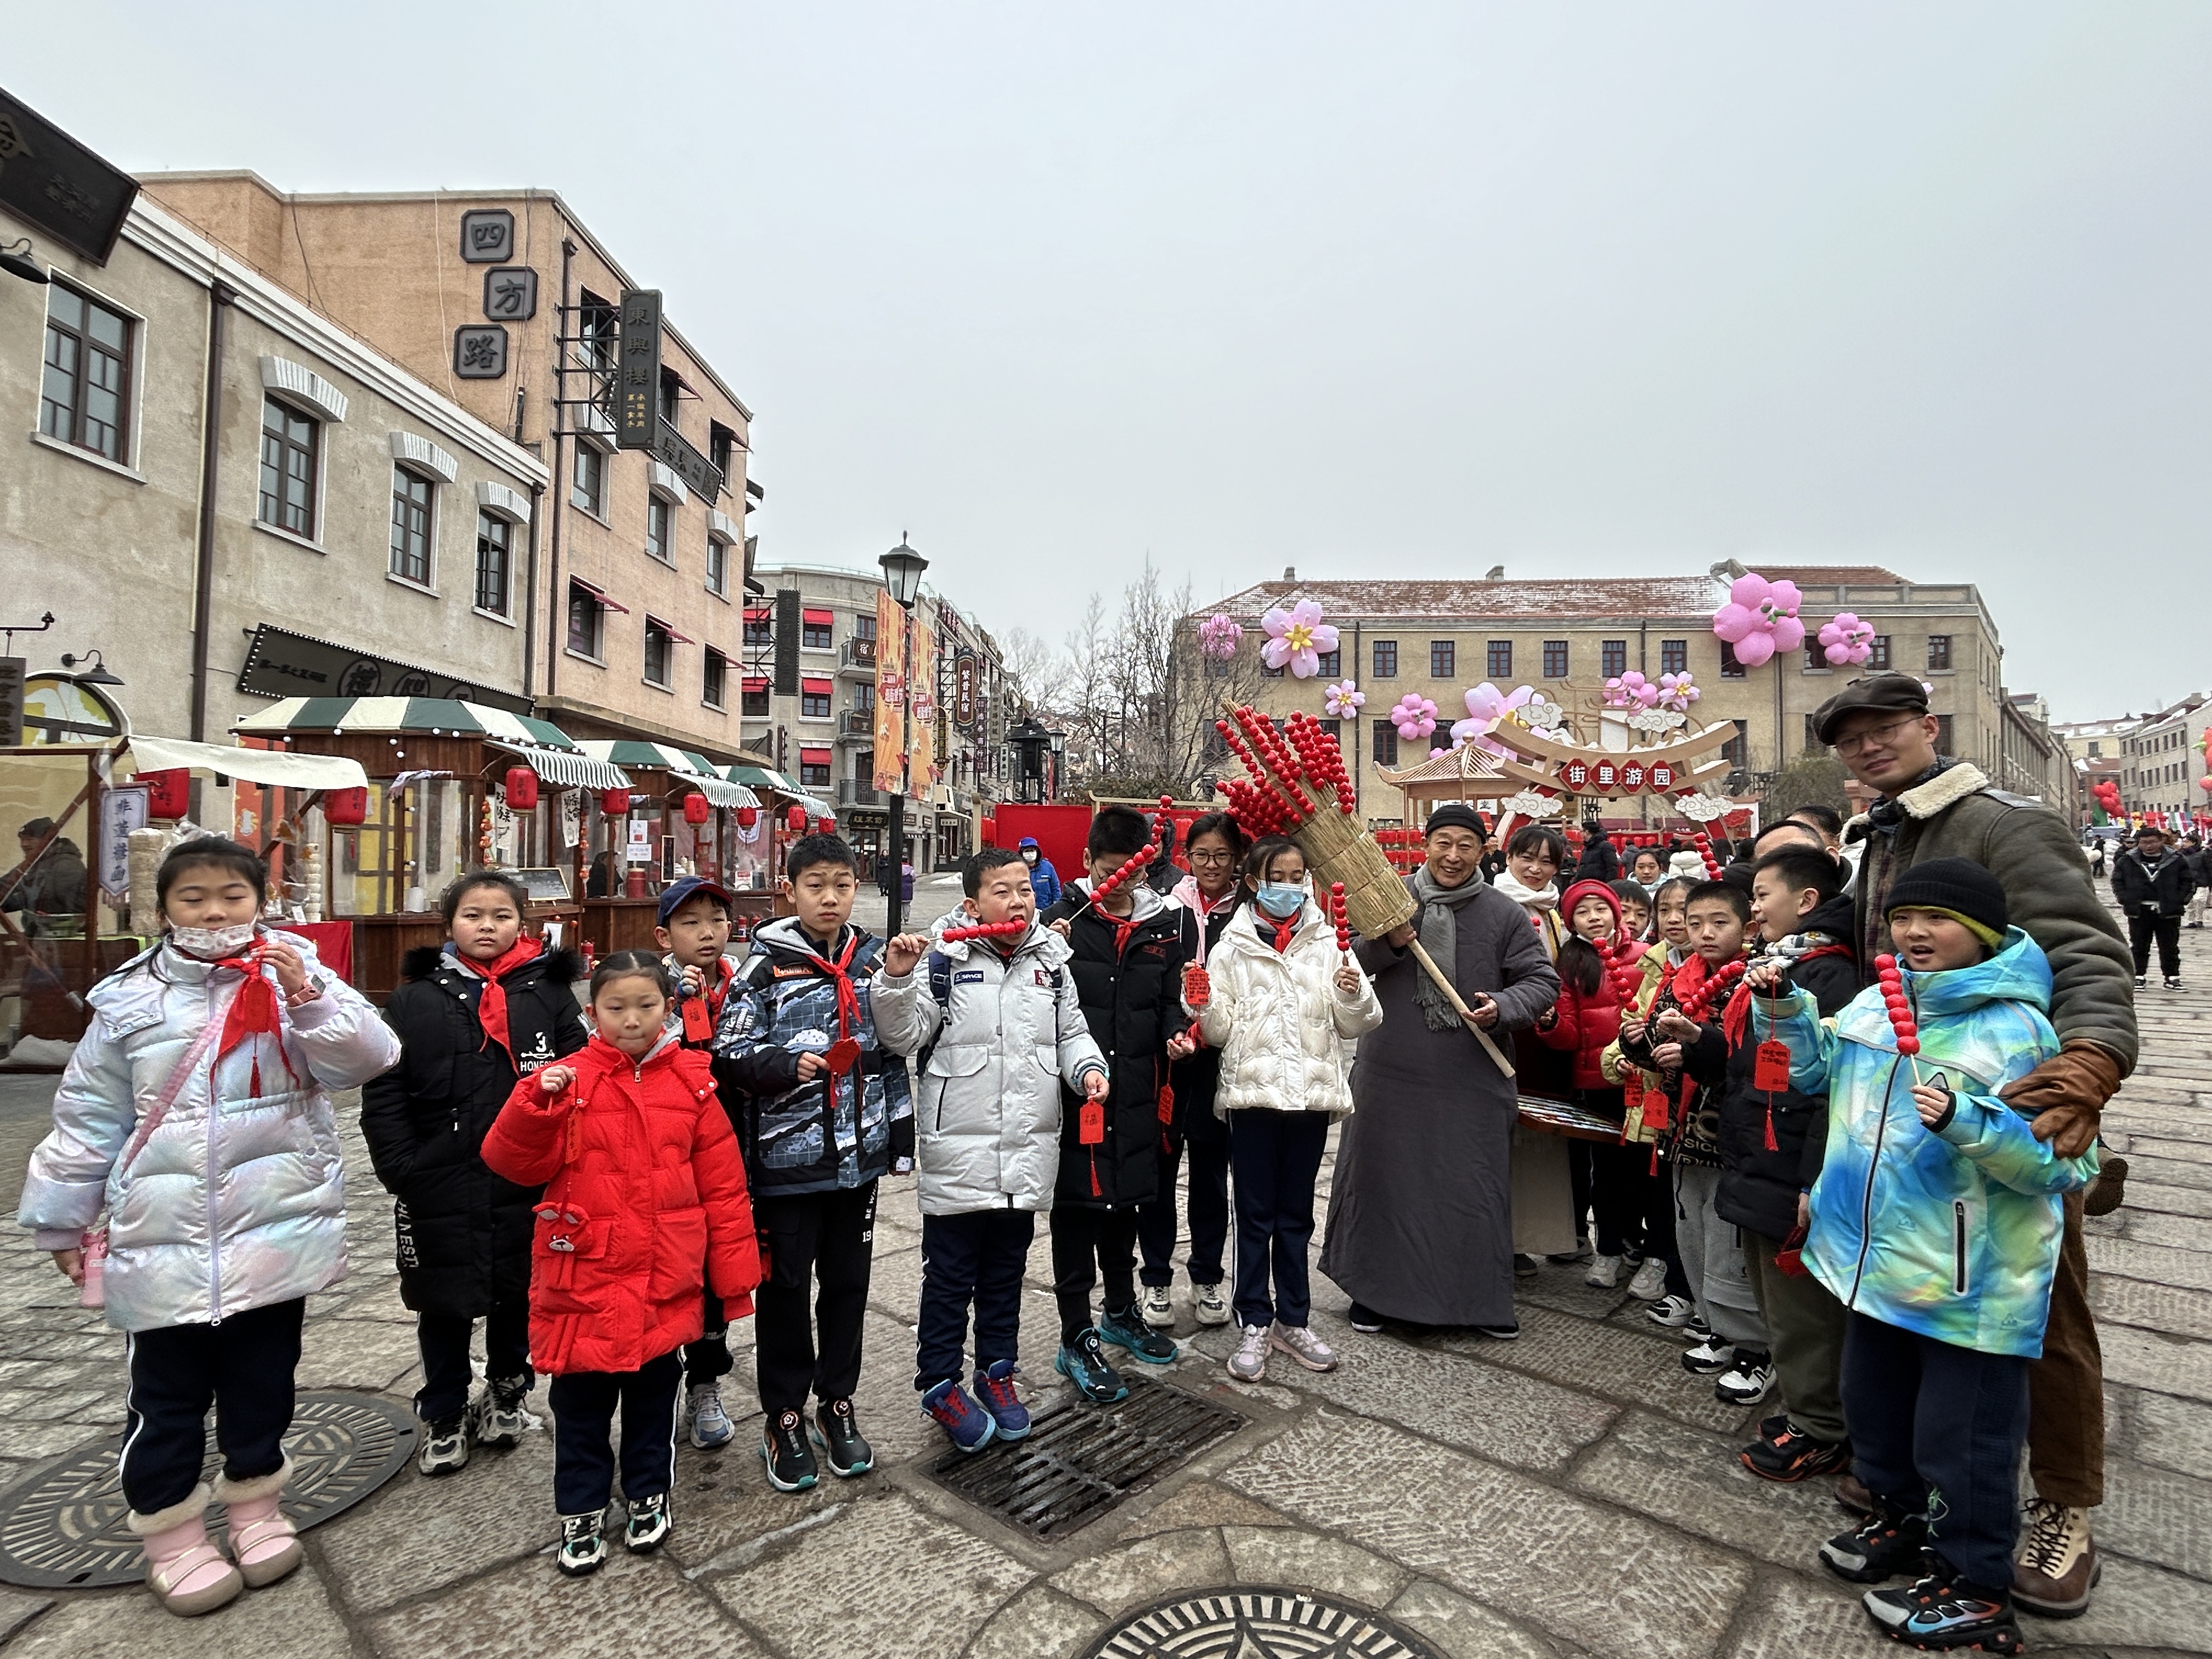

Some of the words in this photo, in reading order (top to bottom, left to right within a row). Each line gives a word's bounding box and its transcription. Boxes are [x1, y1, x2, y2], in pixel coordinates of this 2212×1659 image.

[464, 222, 526, 369] 四方路
[625, 306, 650, 385] 東興樓
[1569, 766, 1671, 786] 街里游园
[520, 1060, 552, 1072] HONE
